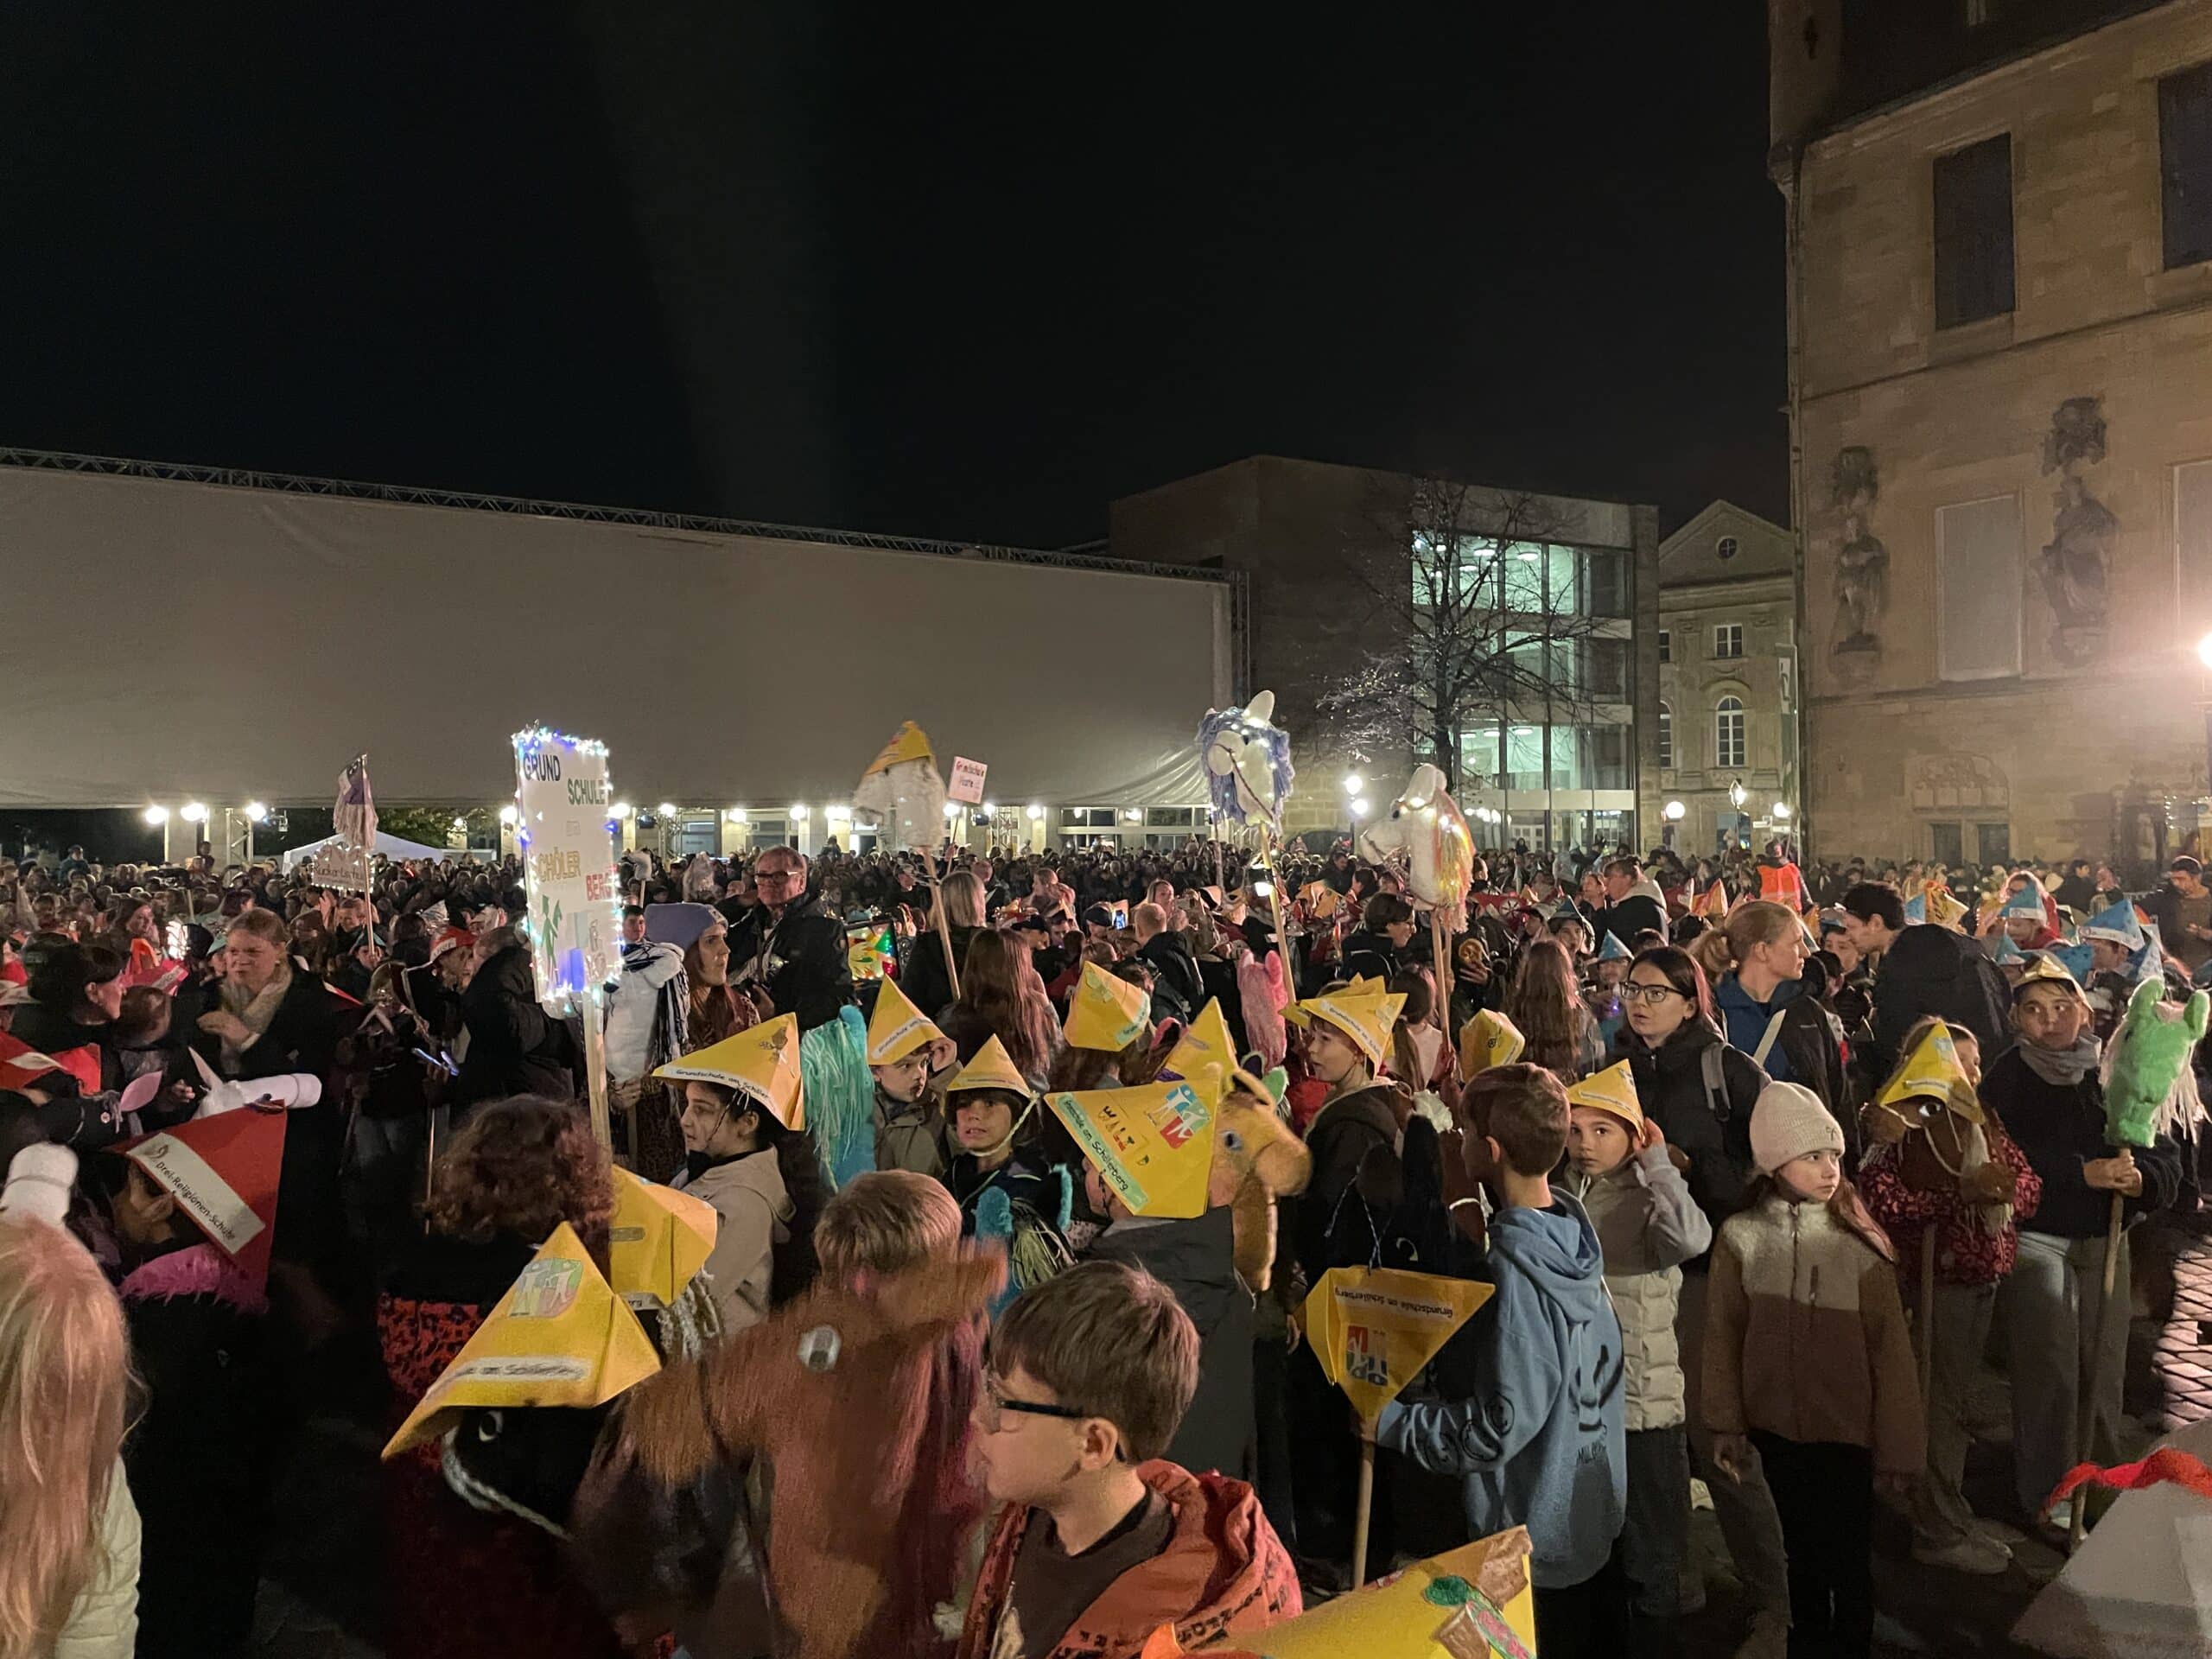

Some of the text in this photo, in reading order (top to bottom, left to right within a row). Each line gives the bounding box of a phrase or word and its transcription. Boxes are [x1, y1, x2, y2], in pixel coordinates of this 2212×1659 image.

[522, 751, 562, 782] GRUND
[567, 778, 606, 805] SCHULE
[676, 1069, 726, 1081] Grundschule
[1082, 1128, 1094, 1142] am
[1090, 1140, 1130, 1193] Schölerberg
[156, 1160, 237, 1242] Drei-Religionen-Schule
